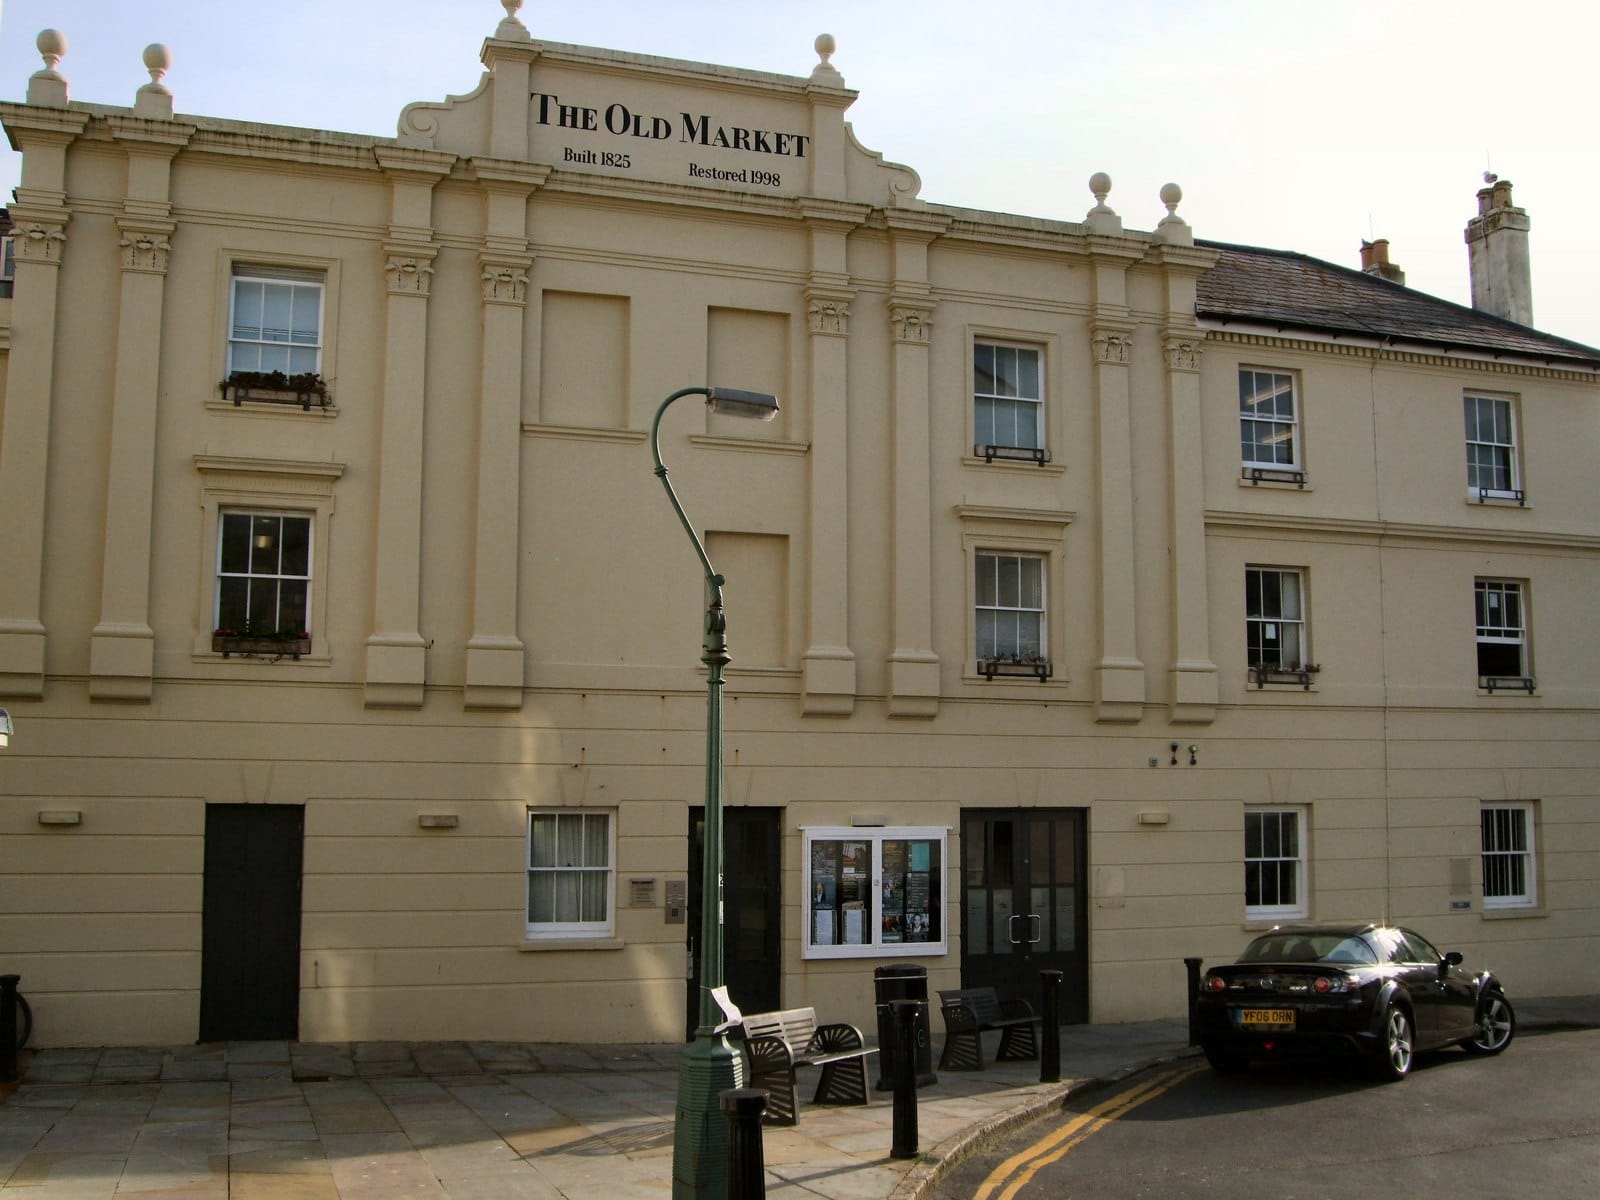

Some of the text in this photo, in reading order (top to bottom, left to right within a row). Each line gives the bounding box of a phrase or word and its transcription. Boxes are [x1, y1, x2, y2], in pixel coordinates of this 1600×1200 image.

[530, 92, 810, 158] THE OLD MARKET
[564, 147, 631, 168] Built 1825
[689, 163, 781, 187] Restored 1998
